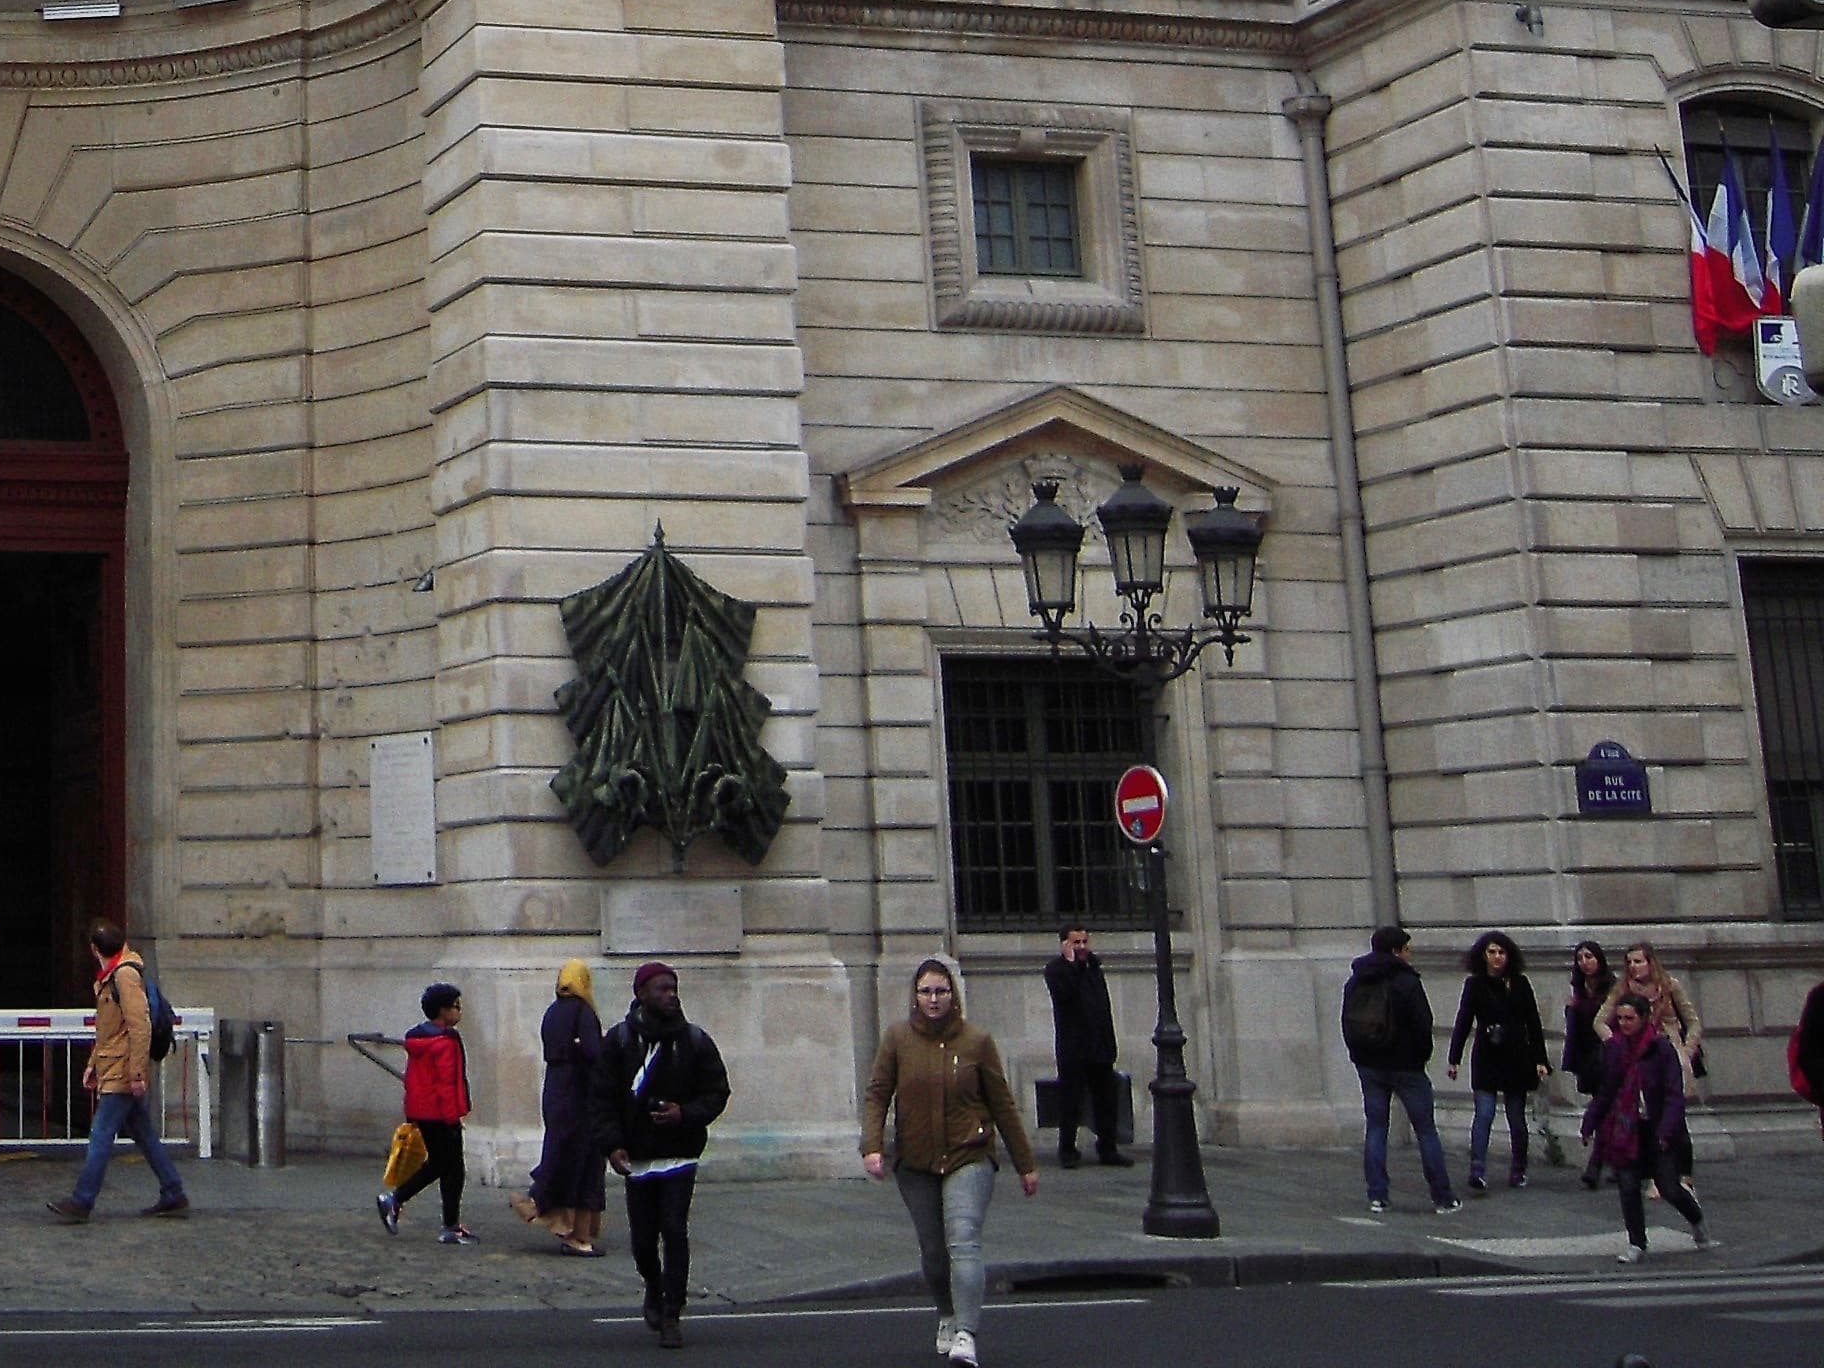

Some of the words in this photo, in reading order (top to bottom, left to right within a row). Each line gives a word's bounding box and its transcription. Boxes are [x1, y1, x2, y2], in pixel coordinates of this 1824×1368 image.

[1604, 776, 1625, 786] RUE
[1588, 790, 1602, 800] DE
[1606, 790, 1617, 800] LA
